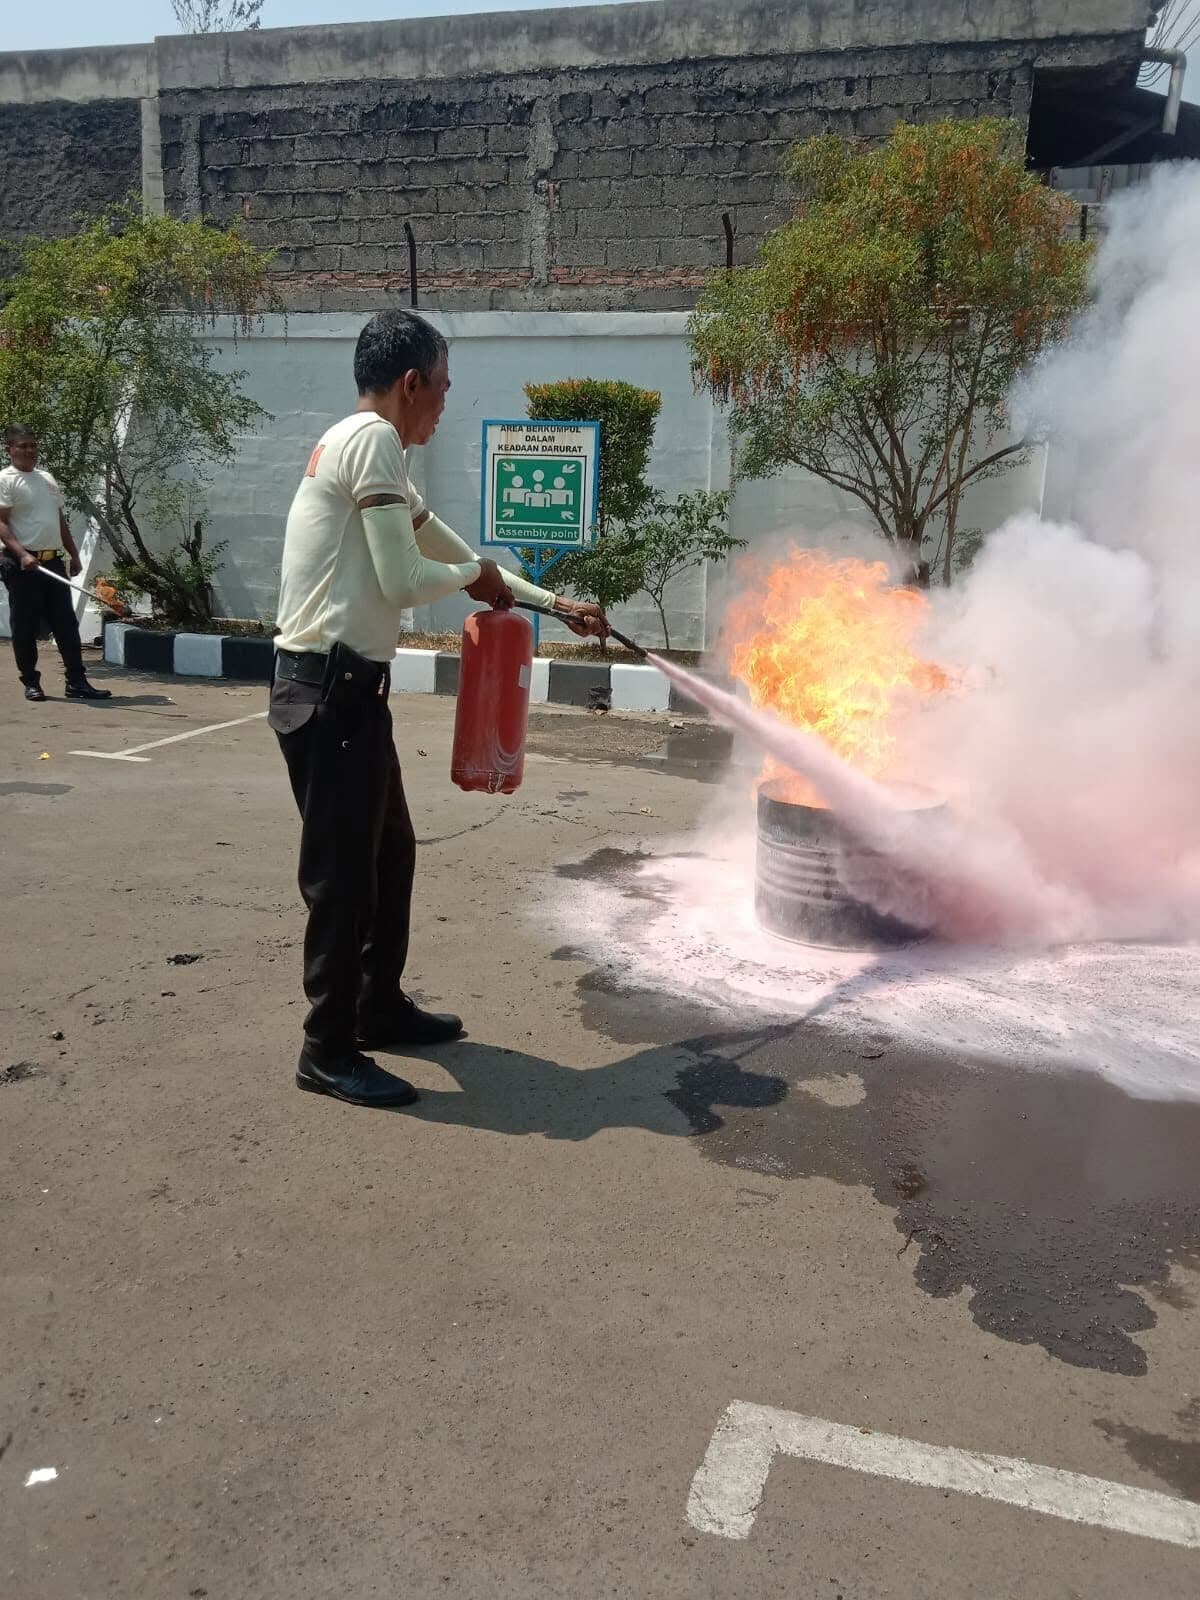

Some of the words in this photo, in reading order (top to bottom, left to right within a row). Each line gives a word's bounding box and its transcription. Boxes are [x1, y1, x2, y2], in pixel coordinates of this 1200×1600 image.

[500, 424, 524, 433] AREA
[526, 425, 581, 433] BERKUMPUL
[525, 434, 555, 443] DALAM
[498, 444, 539, 452] KEADAAN
[541, 445, 583, 453] DARURAT
[498, 527, 548, 539] Assembly
[551, 529, 578, 539] point
